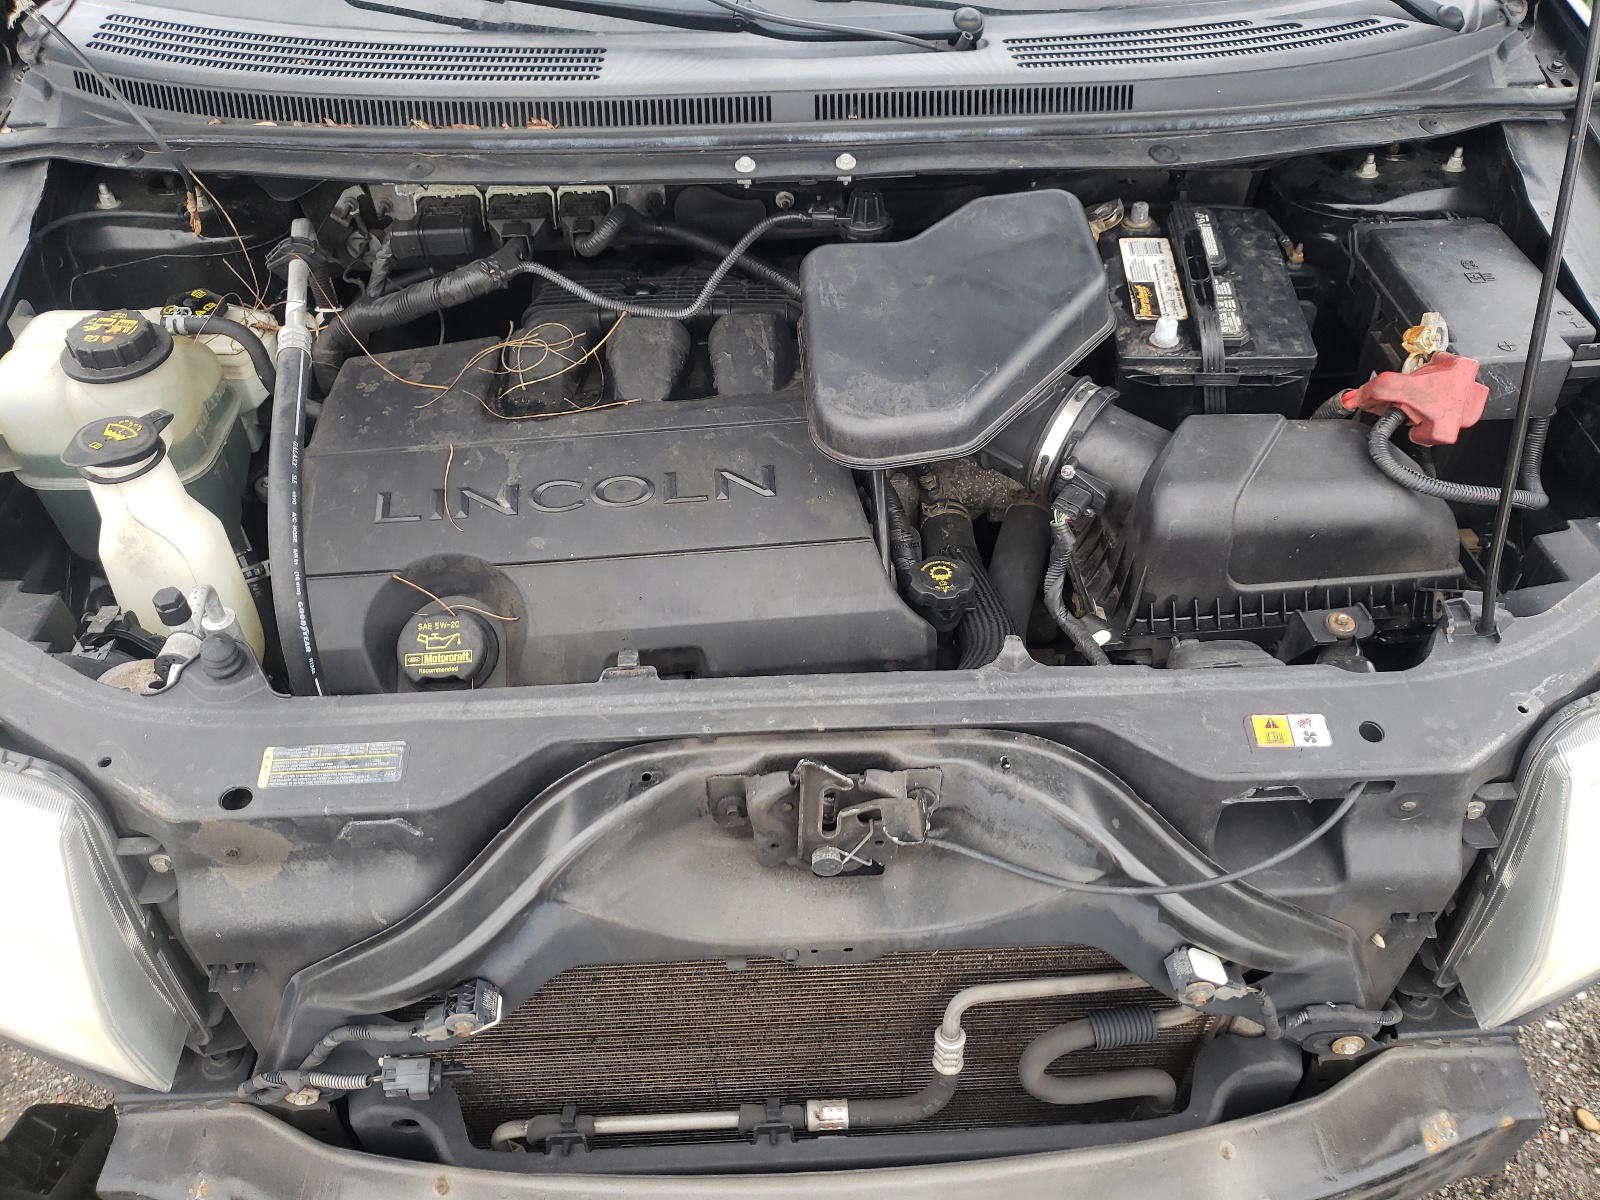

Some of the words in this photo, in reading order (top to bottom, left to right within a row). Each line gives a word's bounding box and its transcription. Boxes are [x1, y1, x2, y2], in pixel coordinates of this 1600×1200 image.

[374, 464, 776, 524] LINCOLN
[417, 623, 433, 631] SAE
[434, 620, 460, 630] 5W-20
[298, 601, 312, 654] GOODYEAR
[308, 657, 316, 675] R134a
[424, 652, 469, 664] Motorcraft
[418, 665, 459, 675] Recommended
